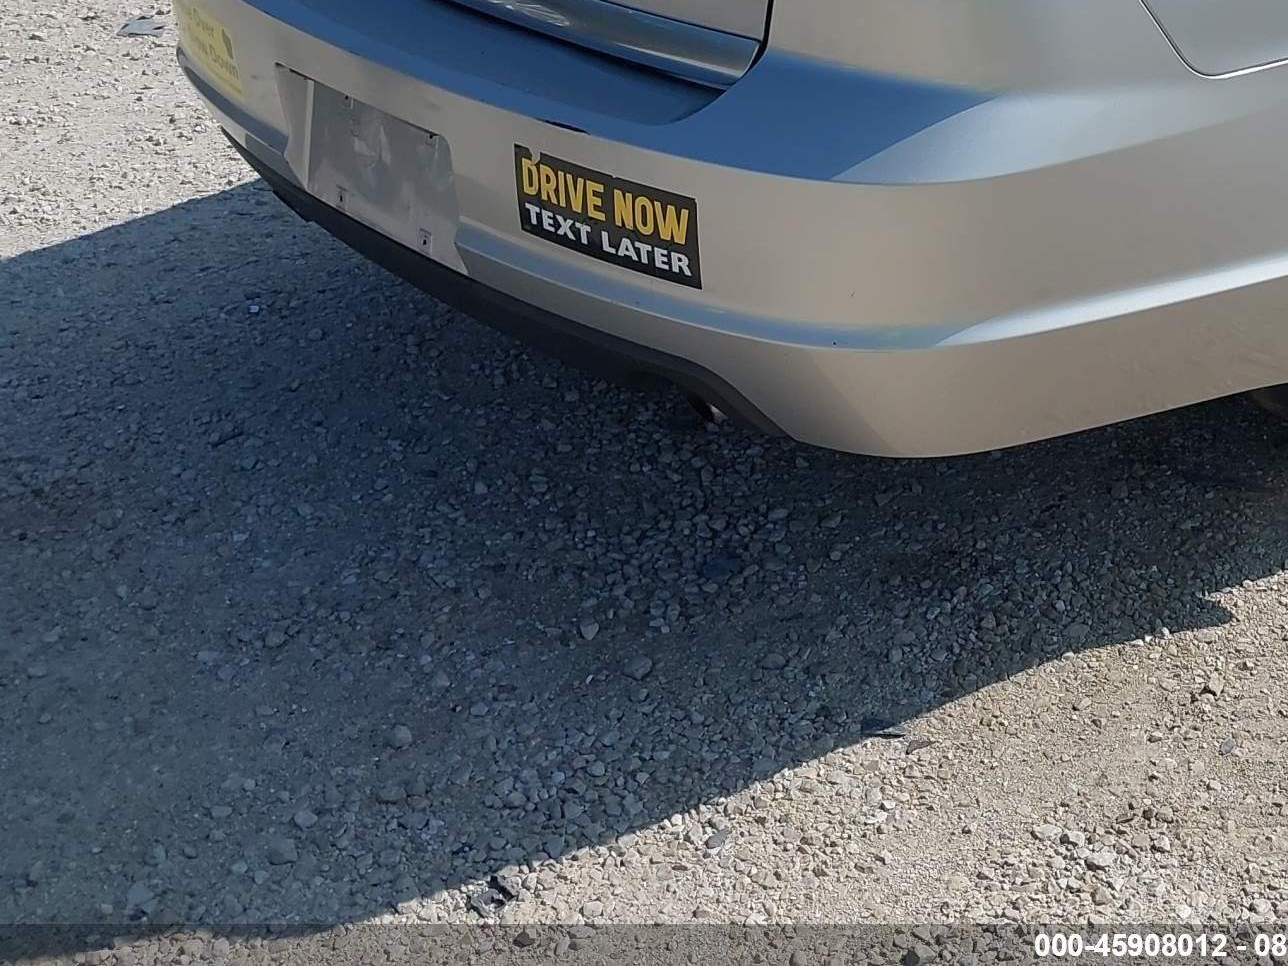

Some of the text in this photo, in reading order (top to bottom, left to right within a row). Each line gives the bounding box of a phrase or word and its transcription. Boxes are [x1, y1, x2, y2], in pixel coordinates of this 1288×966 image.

[521, 157, 689, 245] DRIVE NOW
[524, 202, 692, 276] TEXT LATER
